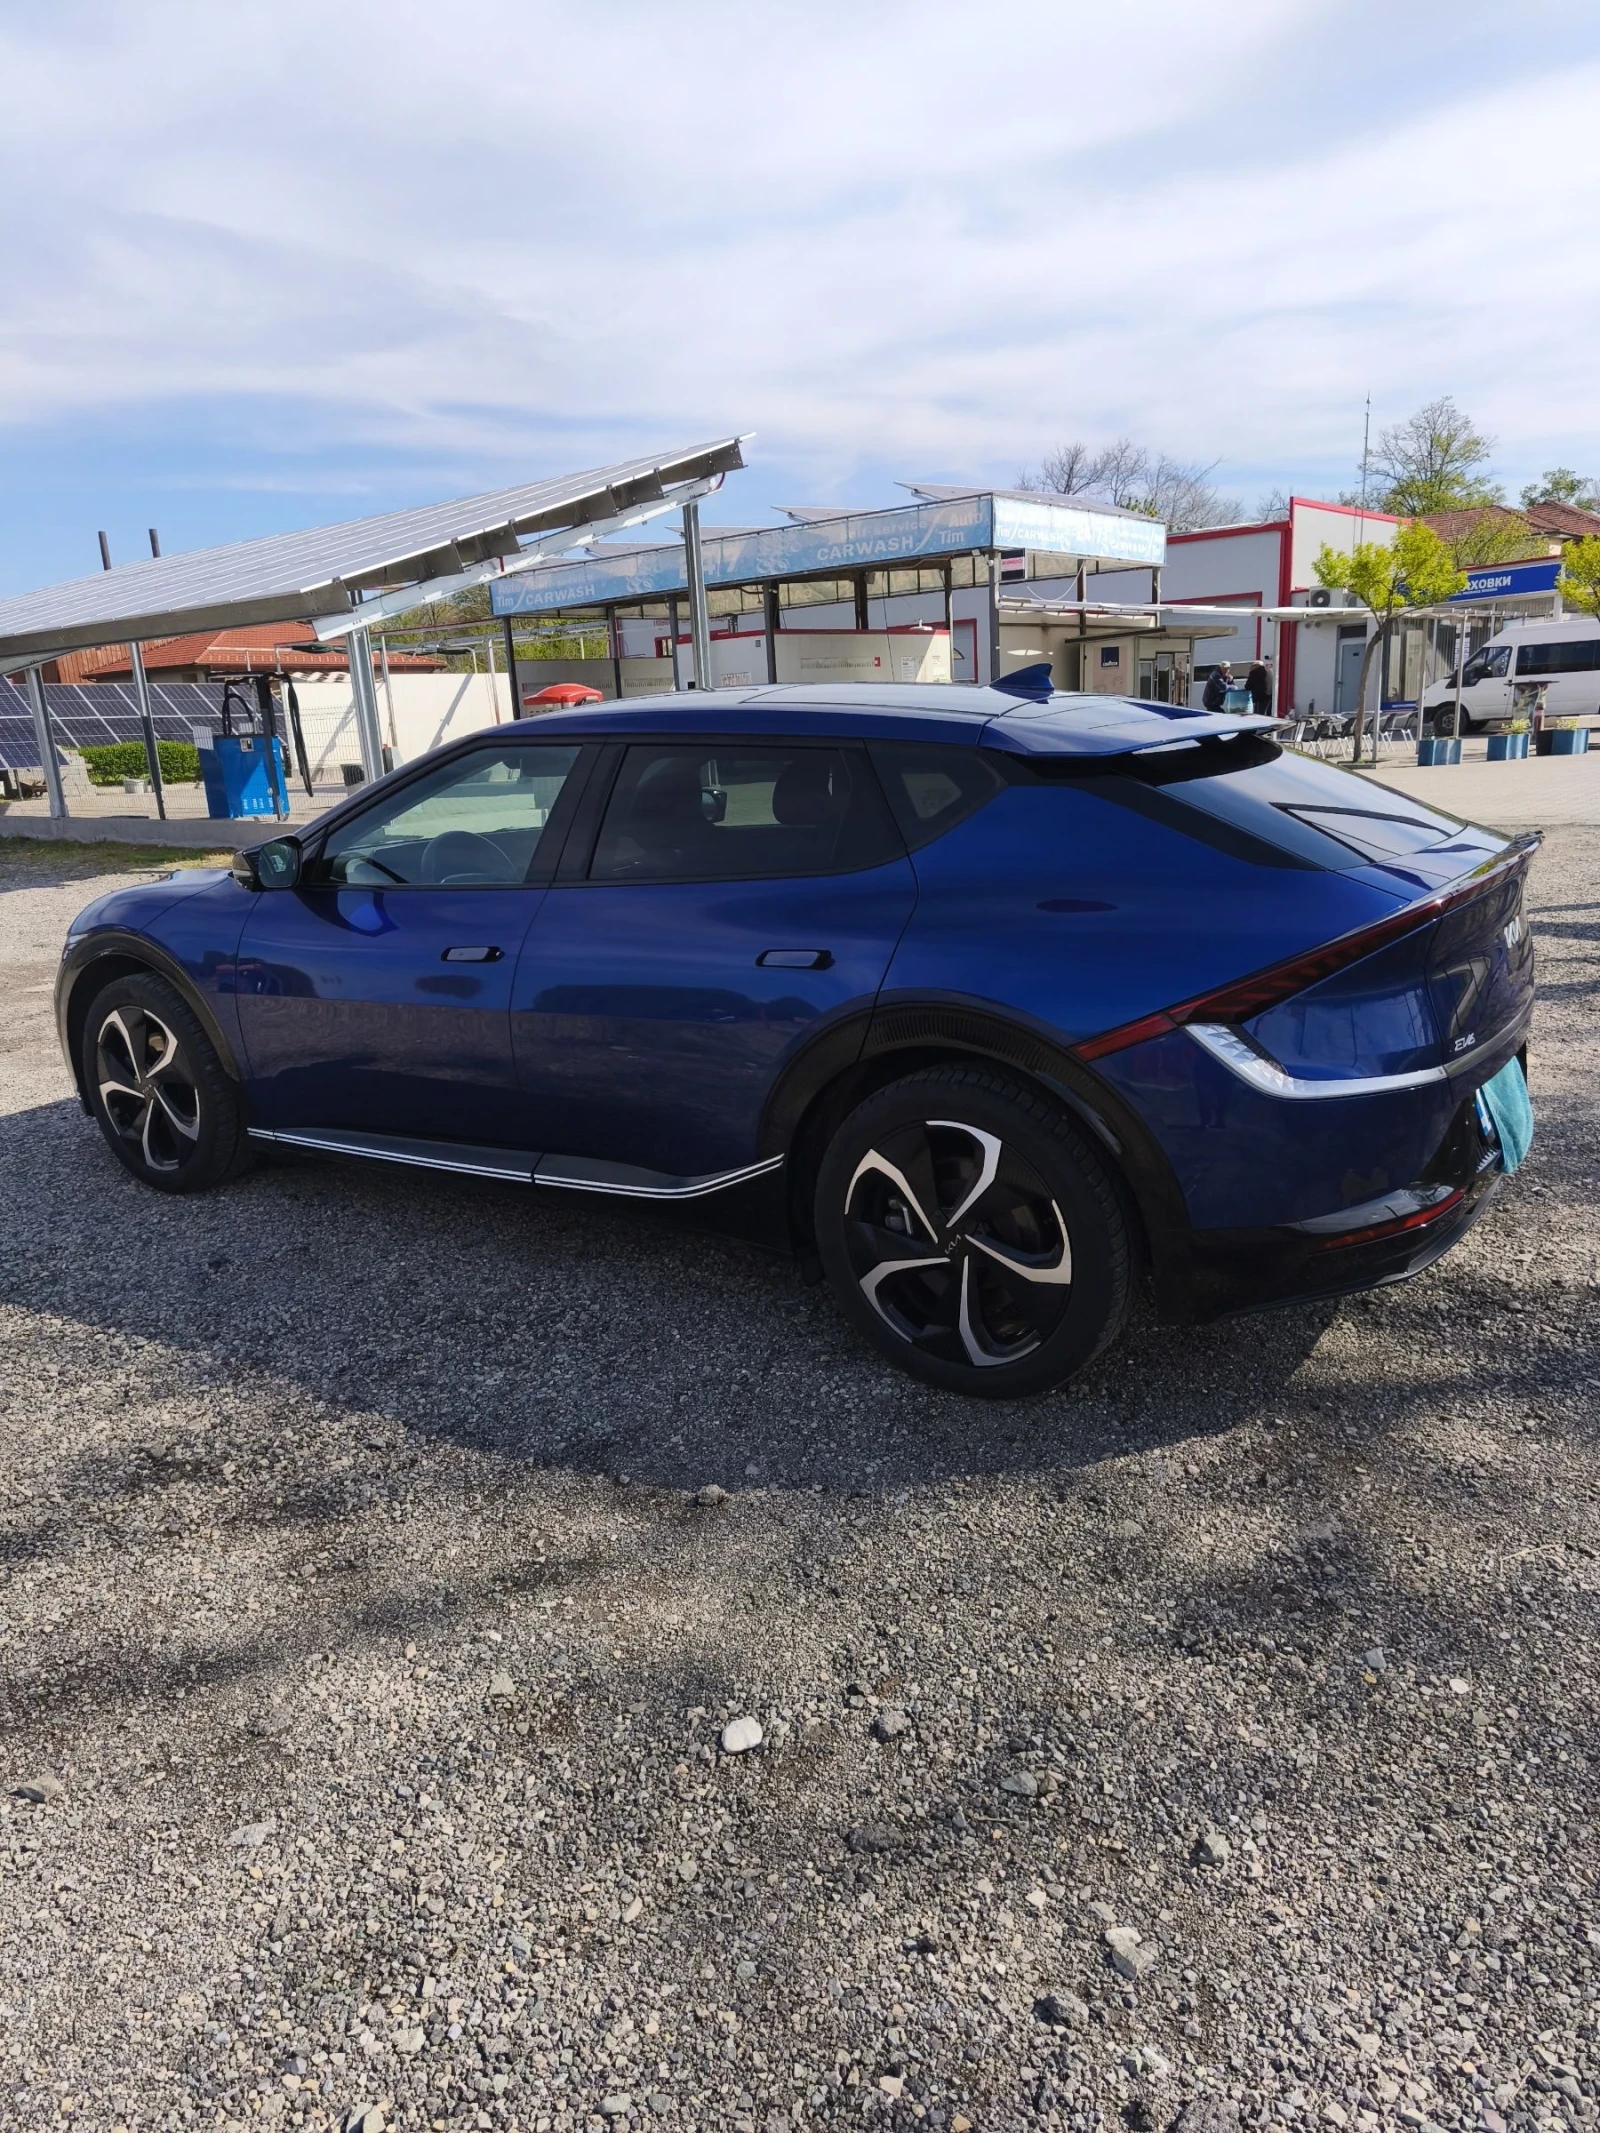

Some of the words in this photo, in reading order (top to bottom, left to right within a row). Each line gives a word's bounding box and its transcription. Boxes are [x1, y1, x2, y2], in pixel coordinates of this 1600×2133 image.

[939, 530, 965, 545] Tim
[816, 535, 914, 561] CARWASH
[1462, 575, 1511, 591] АХОВКИ
[495, 596, 514, 607] Tim
[525, 584, 595, 605] CARWASH
[1454, 1032, 1476, 1052] EV6
